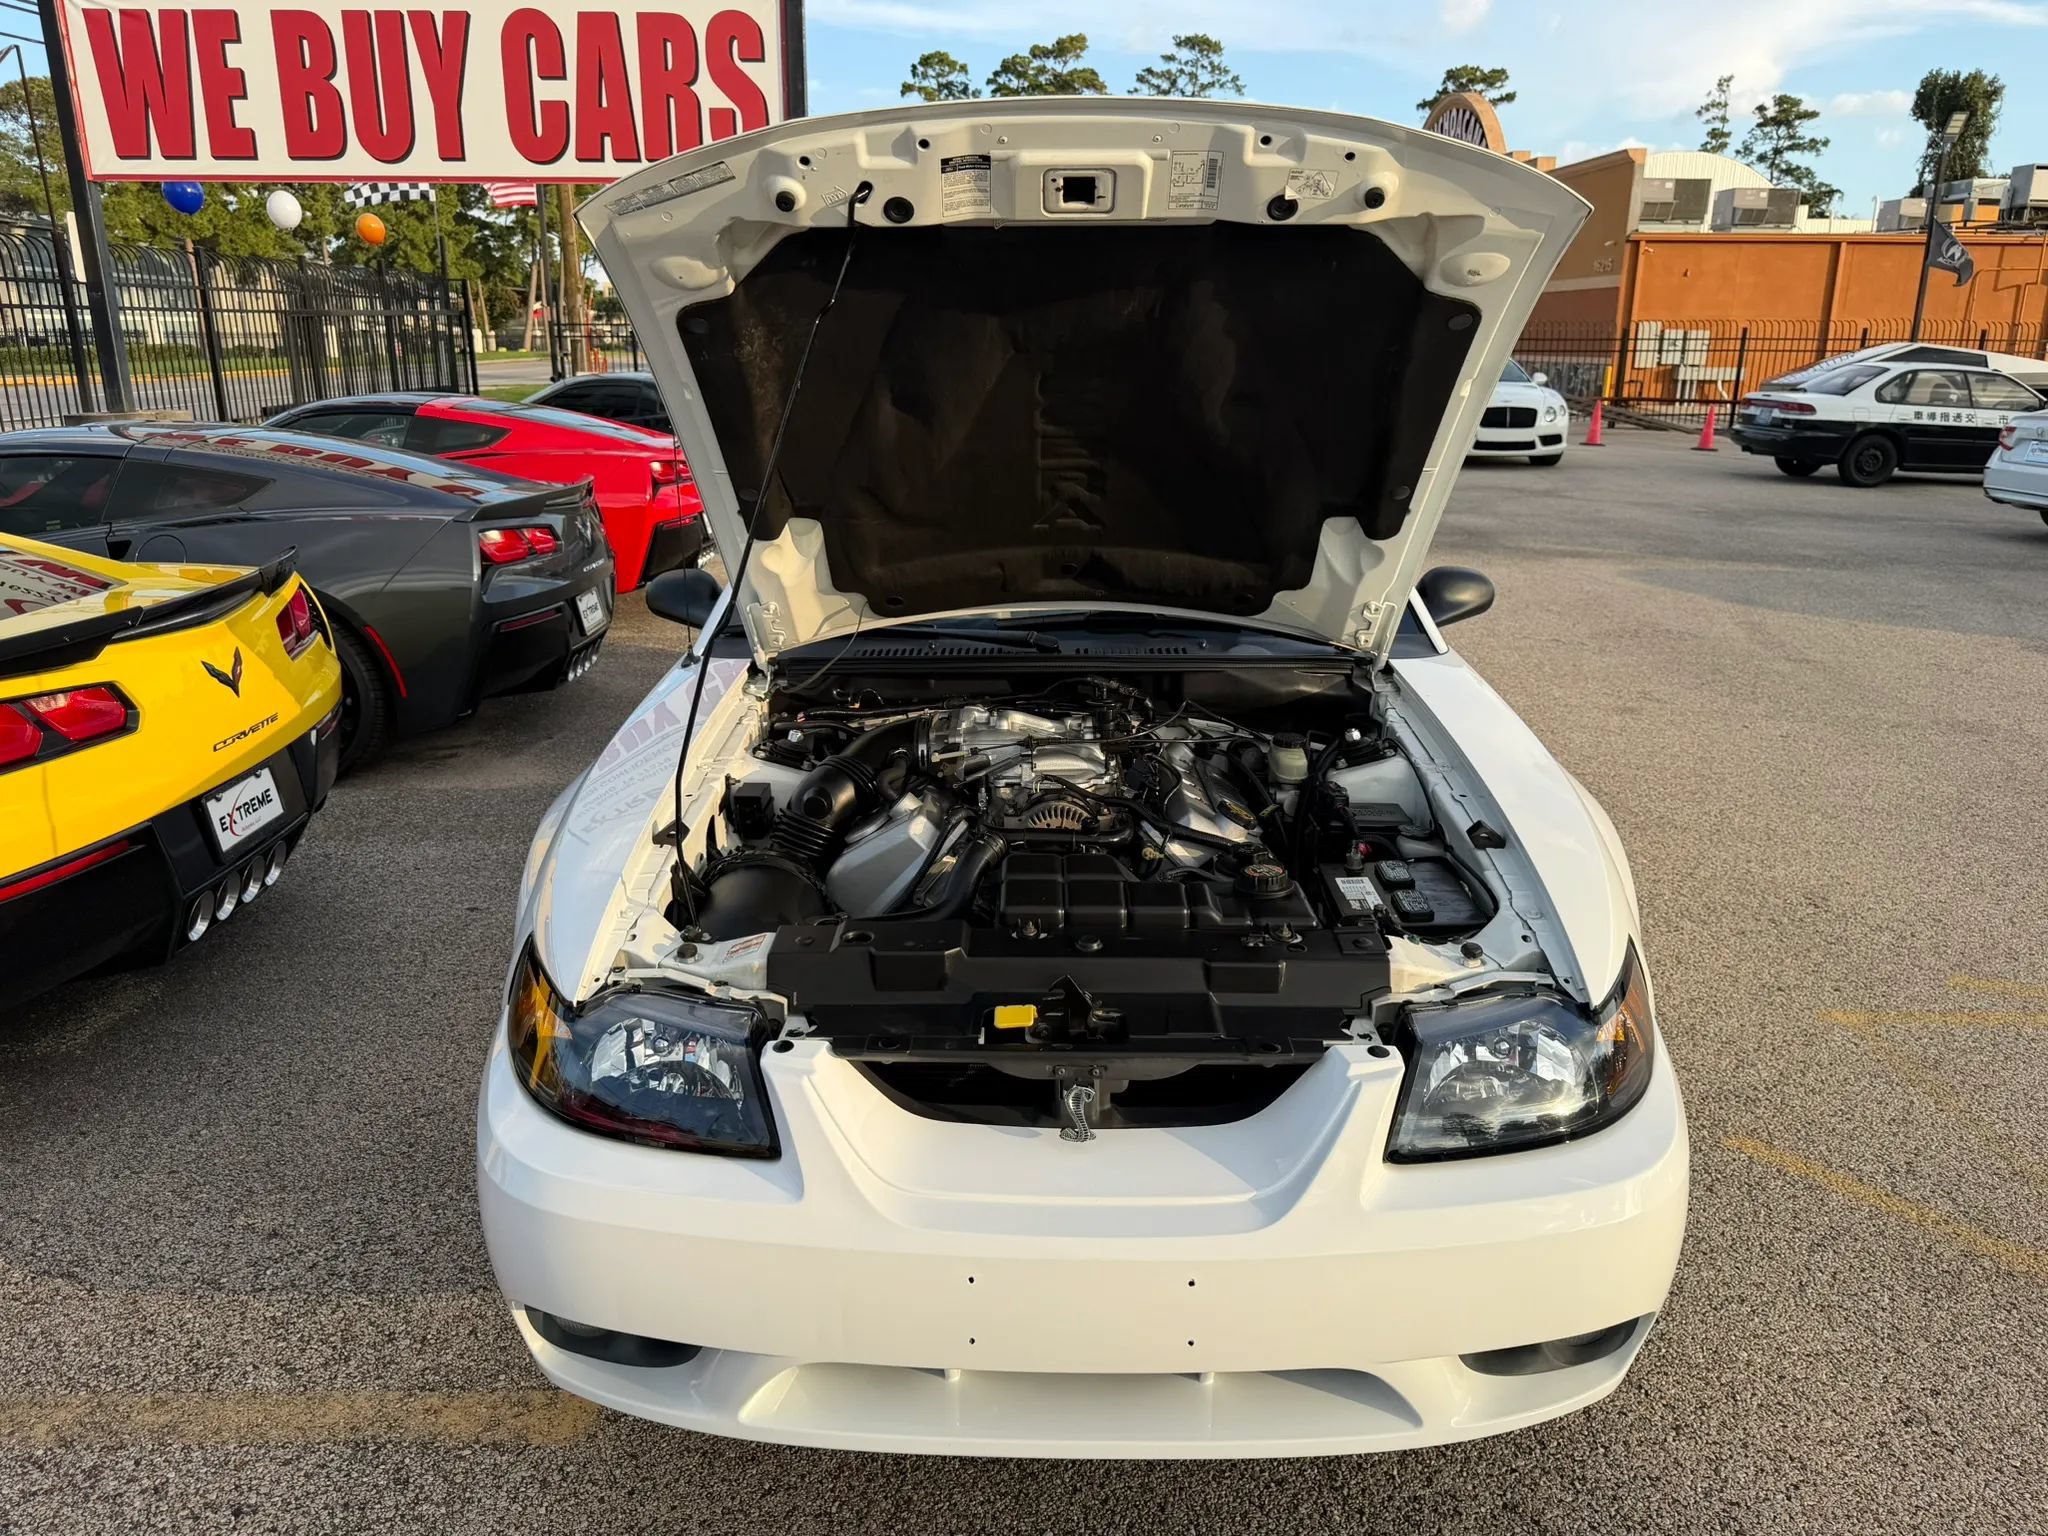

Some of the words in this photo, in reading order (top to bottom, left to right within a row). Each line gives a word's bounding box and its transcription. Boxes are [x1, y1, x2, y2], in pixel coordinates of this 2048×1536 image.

[82, 8, 258, 160] WE
[271, 9, 469, 162] BUY
[501, 7, 769, 164] CARS
[213, 712, 279, 752] CORVETTE
[219, 788, 273, 831] EXTREME
